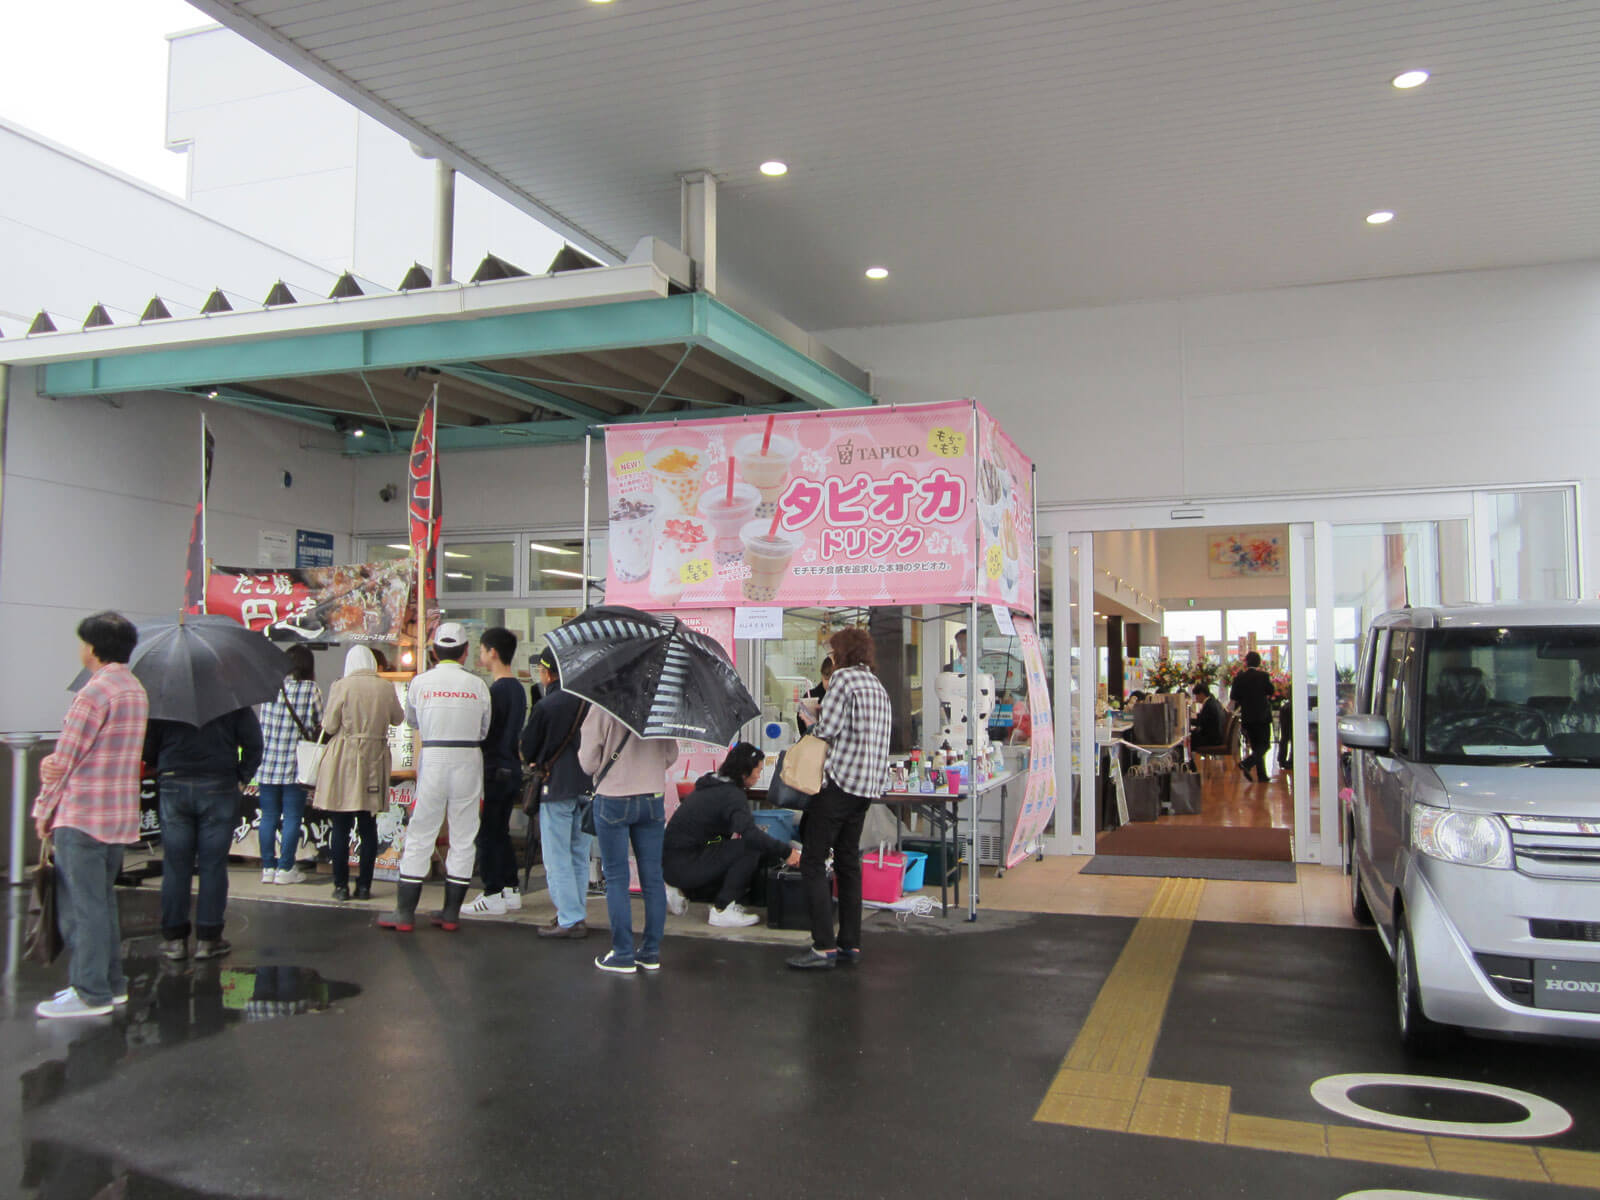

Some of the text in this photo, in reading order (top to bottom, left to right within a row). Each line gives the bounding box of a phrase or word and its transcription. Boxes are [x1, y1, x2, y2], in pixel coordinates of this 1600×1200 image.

[856, 444, 920, 461] TAPICO
[780, 469, 966, 532] タピオカ
[821, 525, 924, 560] ドリンク
[233, 573, 294, 595] たこ焼
[432, 691, 478, 700] HONDA
[1545, 979, 1600, 993] HON
